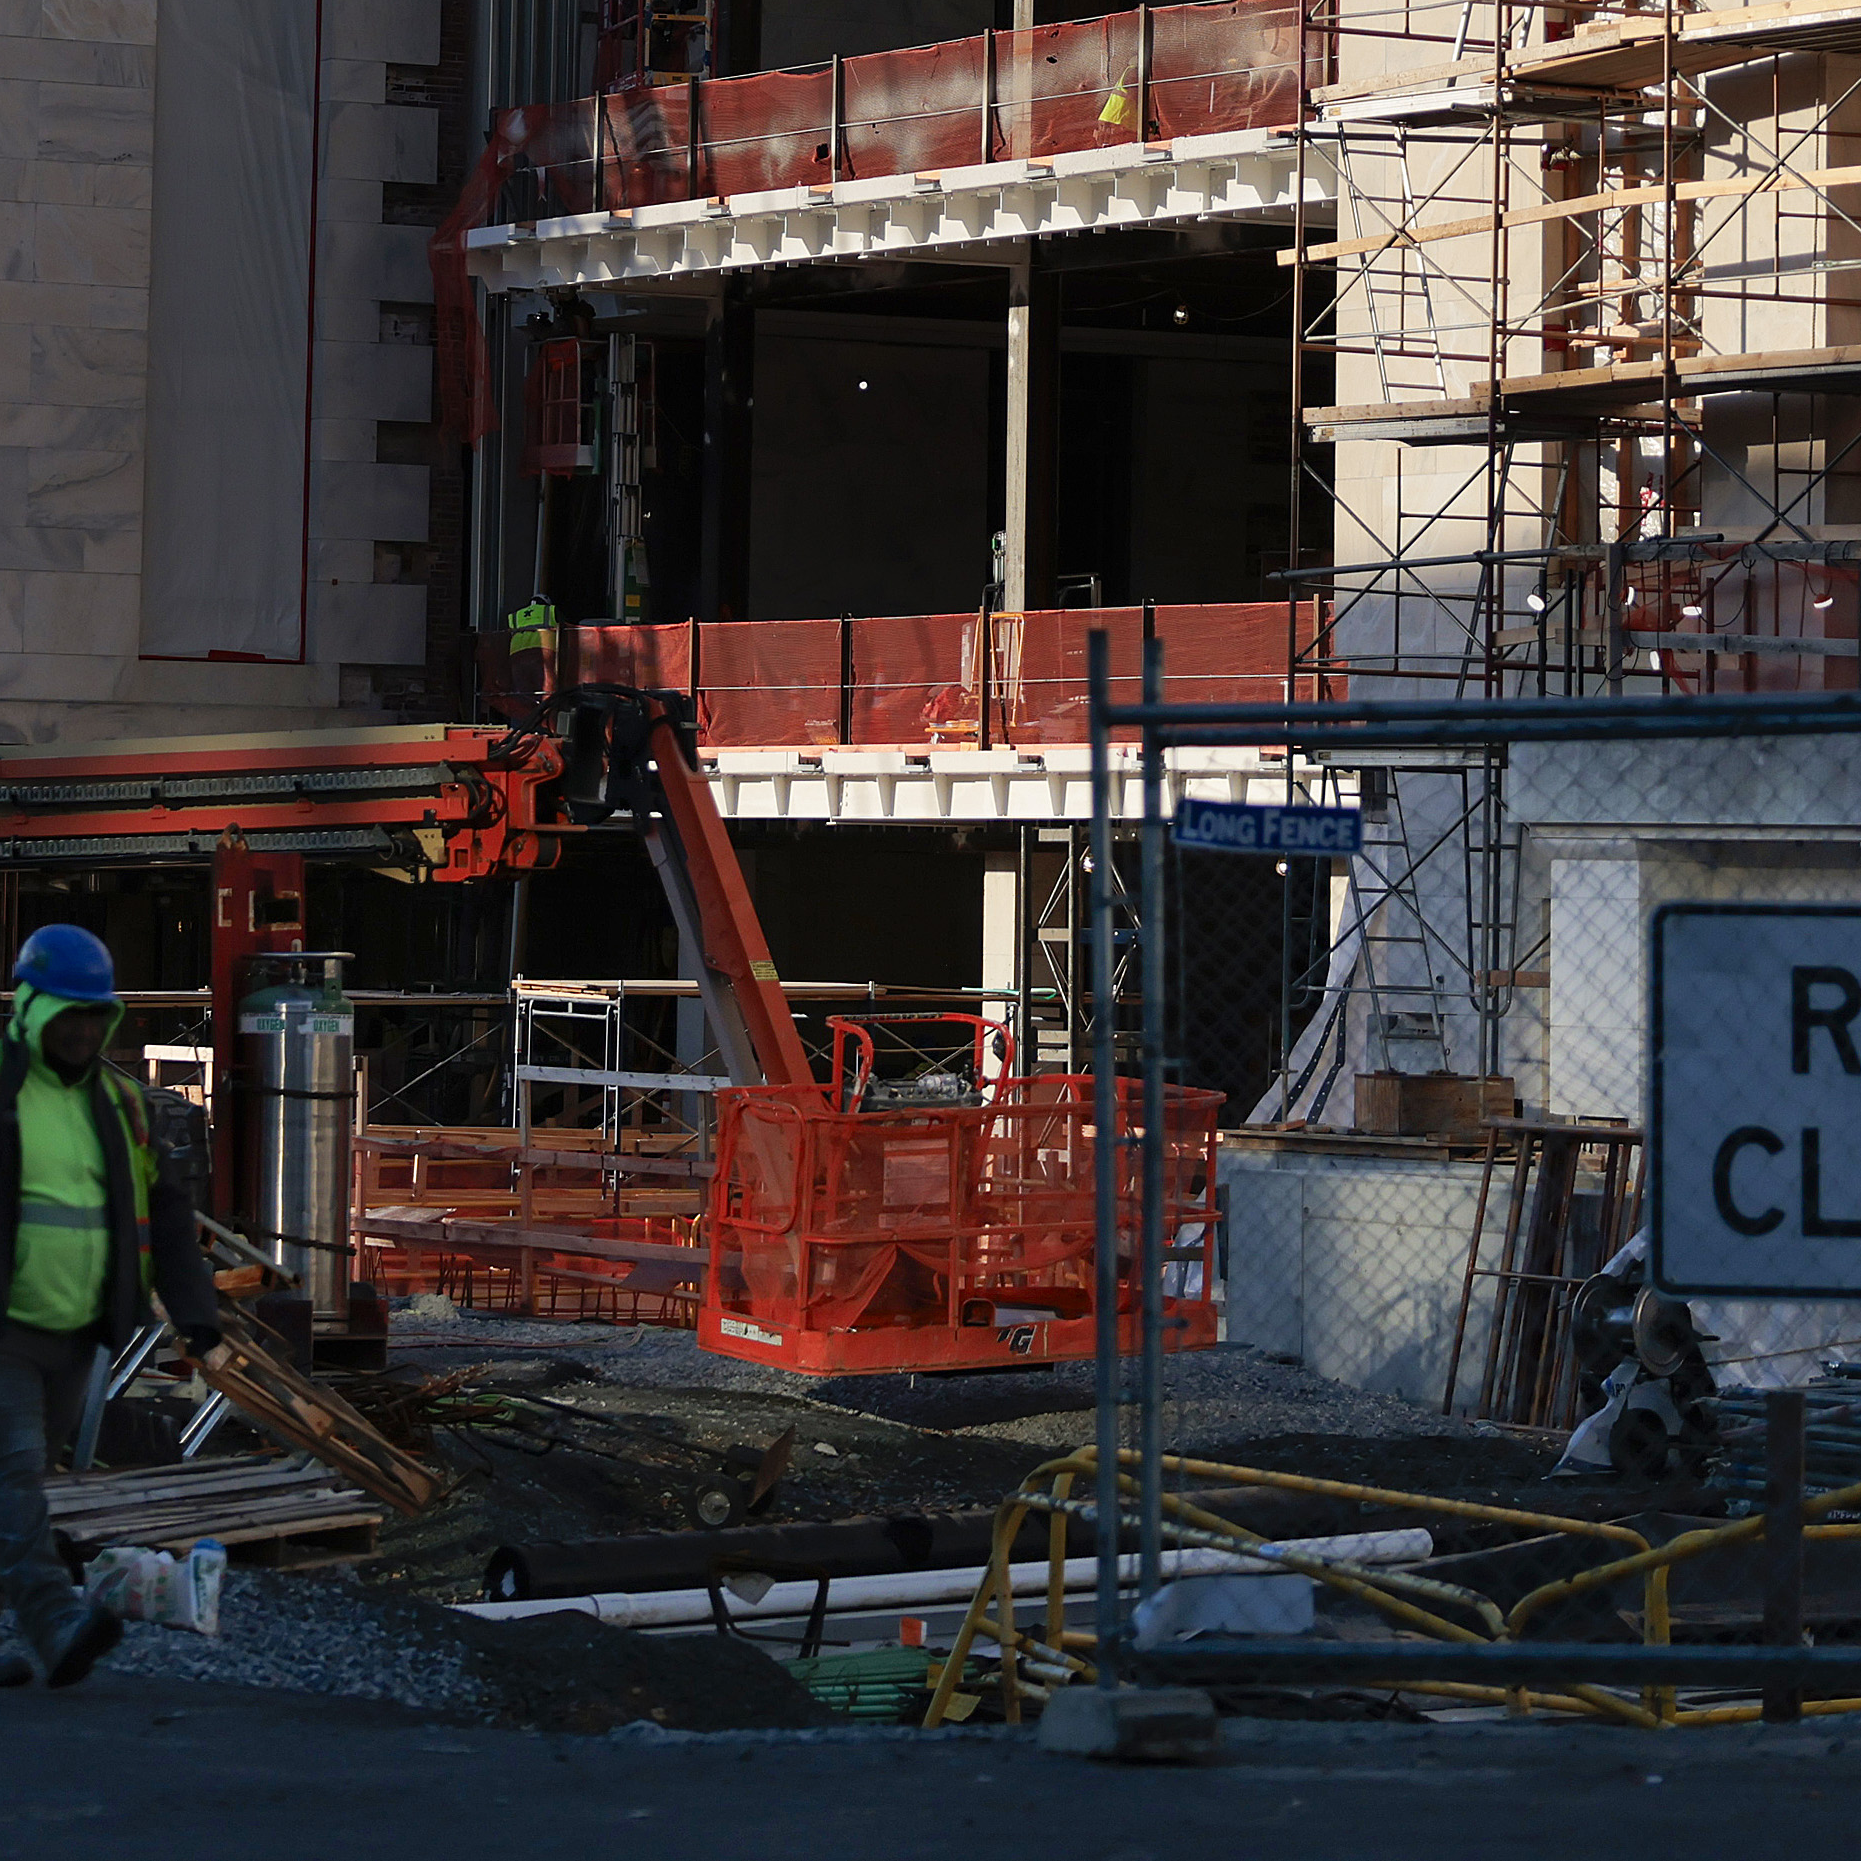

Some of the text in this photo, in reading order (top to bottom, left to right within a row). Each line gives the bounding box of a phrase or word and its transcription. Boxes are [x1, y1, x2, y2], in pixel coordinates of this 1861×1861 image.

[1182, 802, 1354, 848] LONG FENCE
[257, 1018, 285, 1031] OXYGEN
[313, 1019, 340, 1032] OXYGEN
